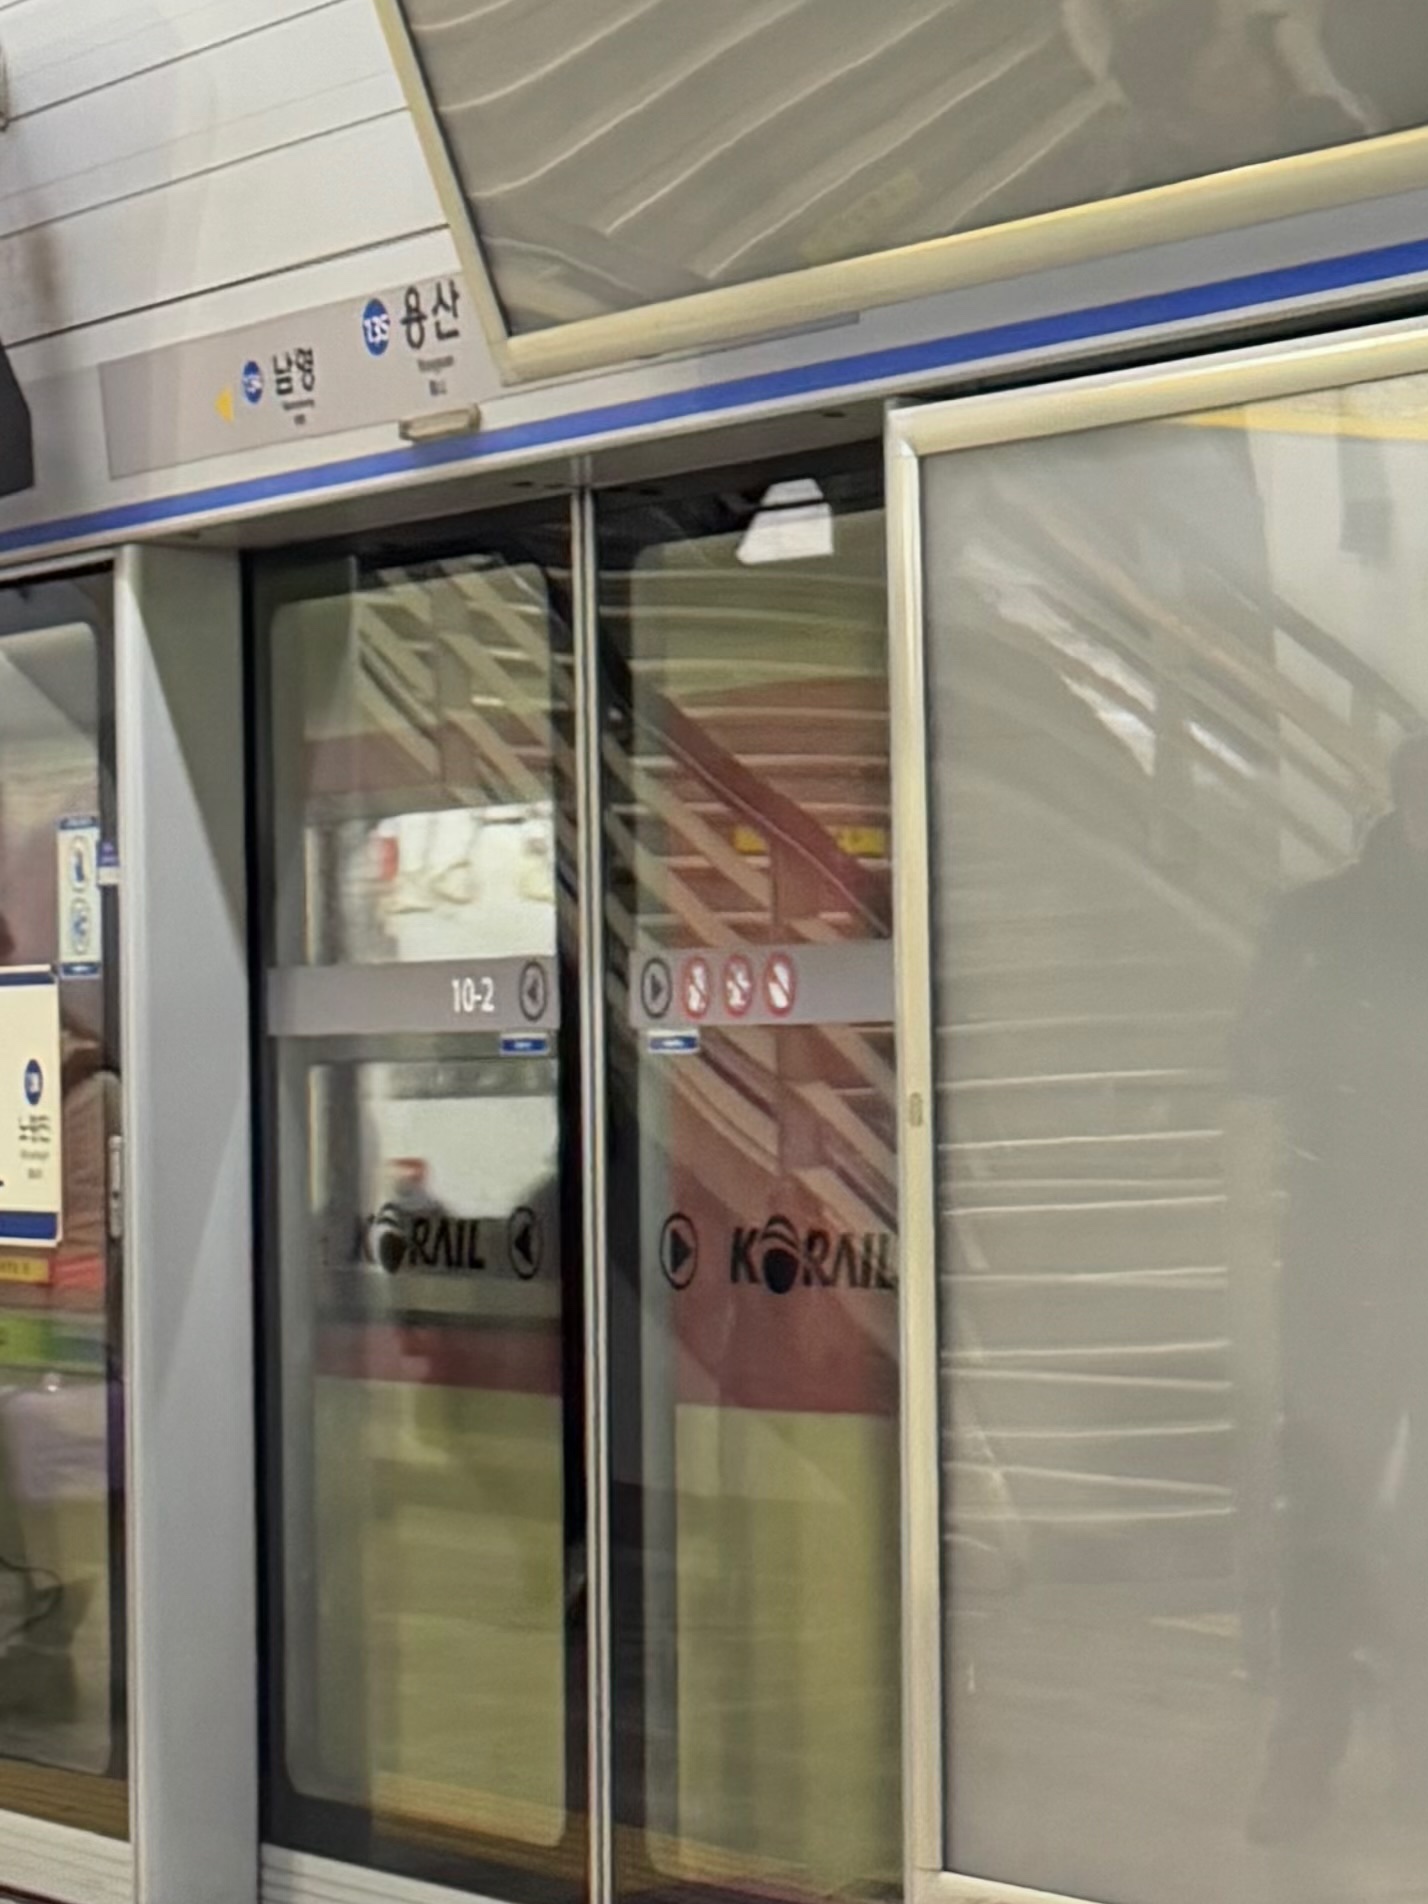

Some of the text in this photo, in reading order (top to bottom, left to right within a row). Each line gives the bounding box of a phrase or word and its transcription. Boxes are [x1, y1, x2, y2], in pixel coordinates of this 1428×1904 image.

[400, 280, 460, 350] 용산
[273, 347, 315, 396] 남영
[452, 976, 495, 1013] 10-2
[730, 1214, 899, 1294] KORAIL
